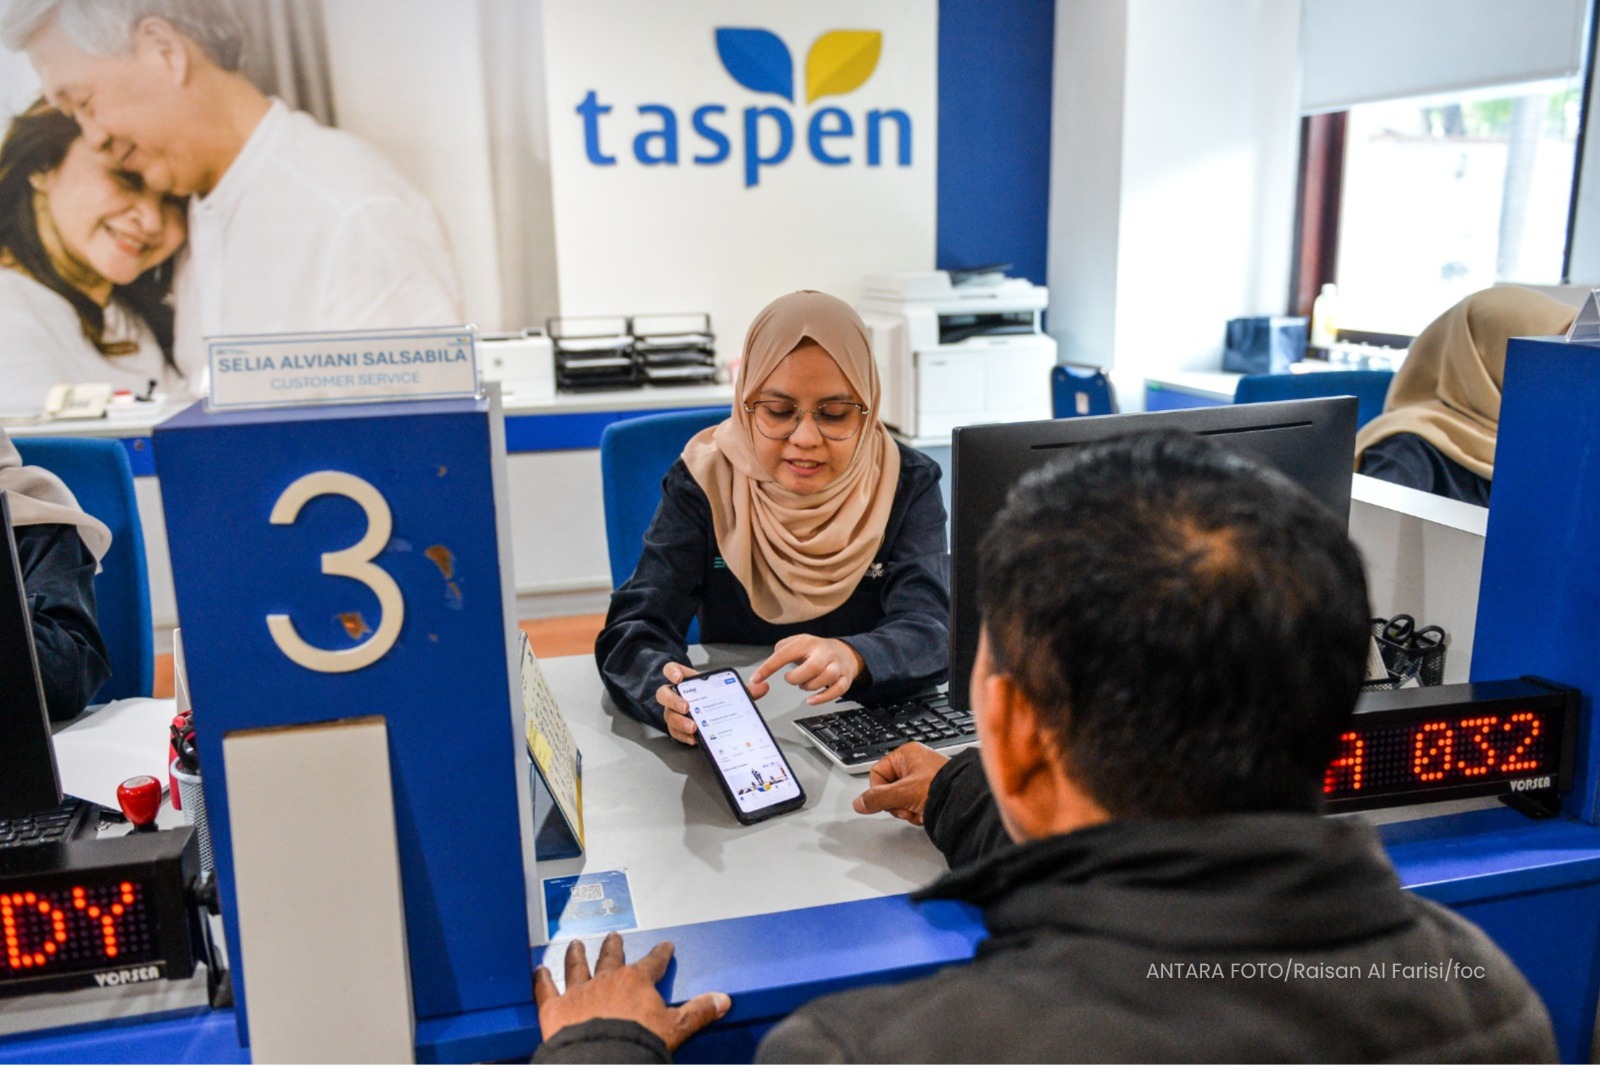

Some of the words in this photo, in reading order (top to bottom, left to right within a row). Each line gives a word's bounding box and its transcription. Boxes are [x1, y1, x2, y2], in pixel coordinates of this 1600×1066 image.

[575, 90, 912, 188] taspen
[218, 355, 276, 373] SELIA
[280, 352, 358, 370] ALVIANI
[363, 348, 468, 367] SALSABILA
[270, 374, 355, 390] CUSTOMER
[358, 371, 421, 386] SERVICE
[266, 470, 404, 672] 3
[1413, 712, 1540, 780] 032
[1509, 776, 1551, 792] VORSEA
[0, 881, 134, 969] DY
